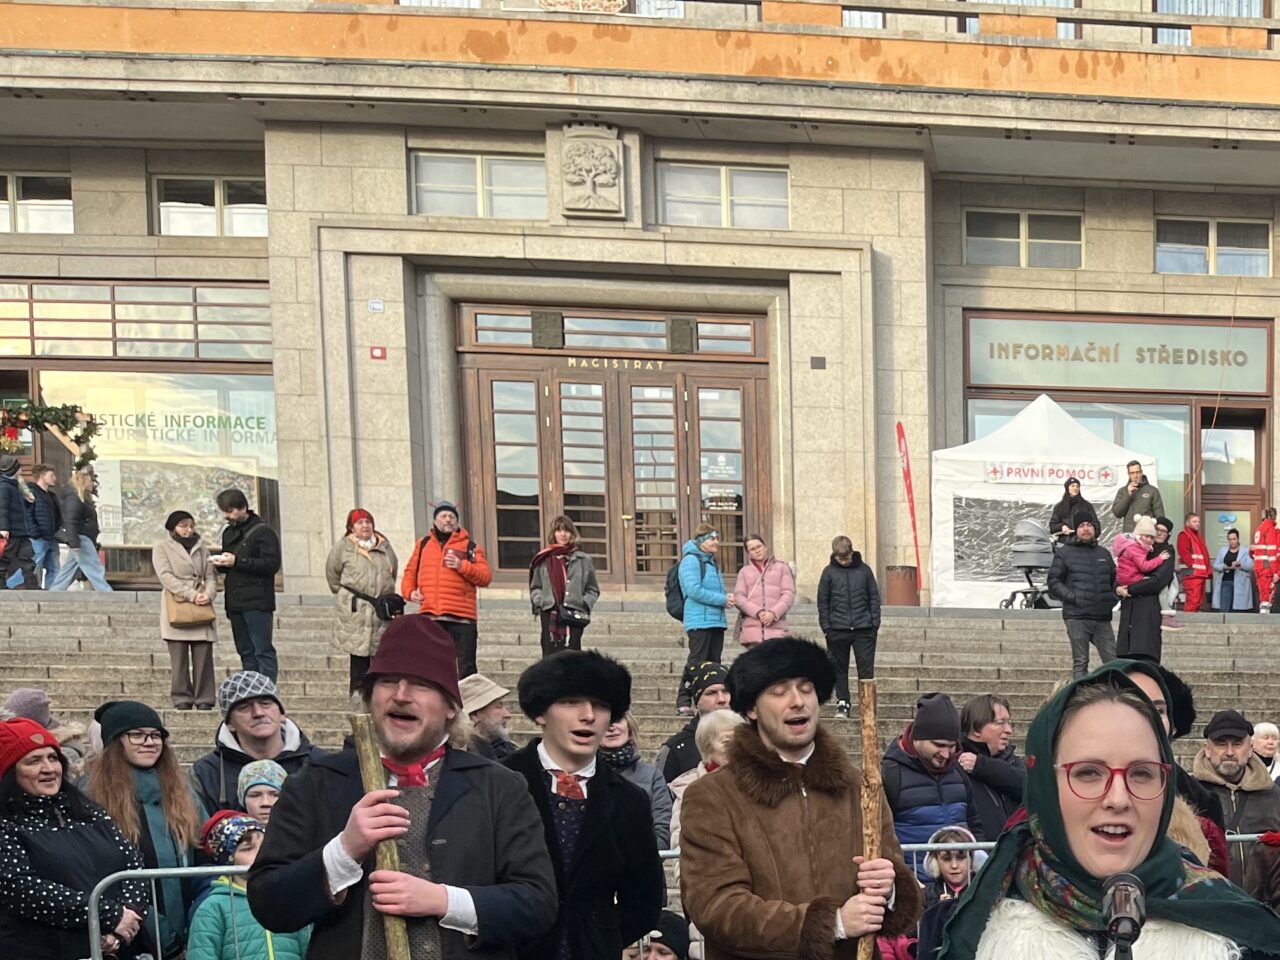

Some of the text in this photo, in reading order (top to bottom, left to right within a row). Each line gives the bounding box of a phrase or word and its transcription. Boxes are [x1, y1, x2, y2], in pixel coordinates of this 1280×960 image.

[988, 341, 1249, 367] INFORMAČNÍ STŘEDISKO
[164, 414, 266, 430] INFORMACE
[1006, 465, 1095, 480] PRVNÍ POMOC
